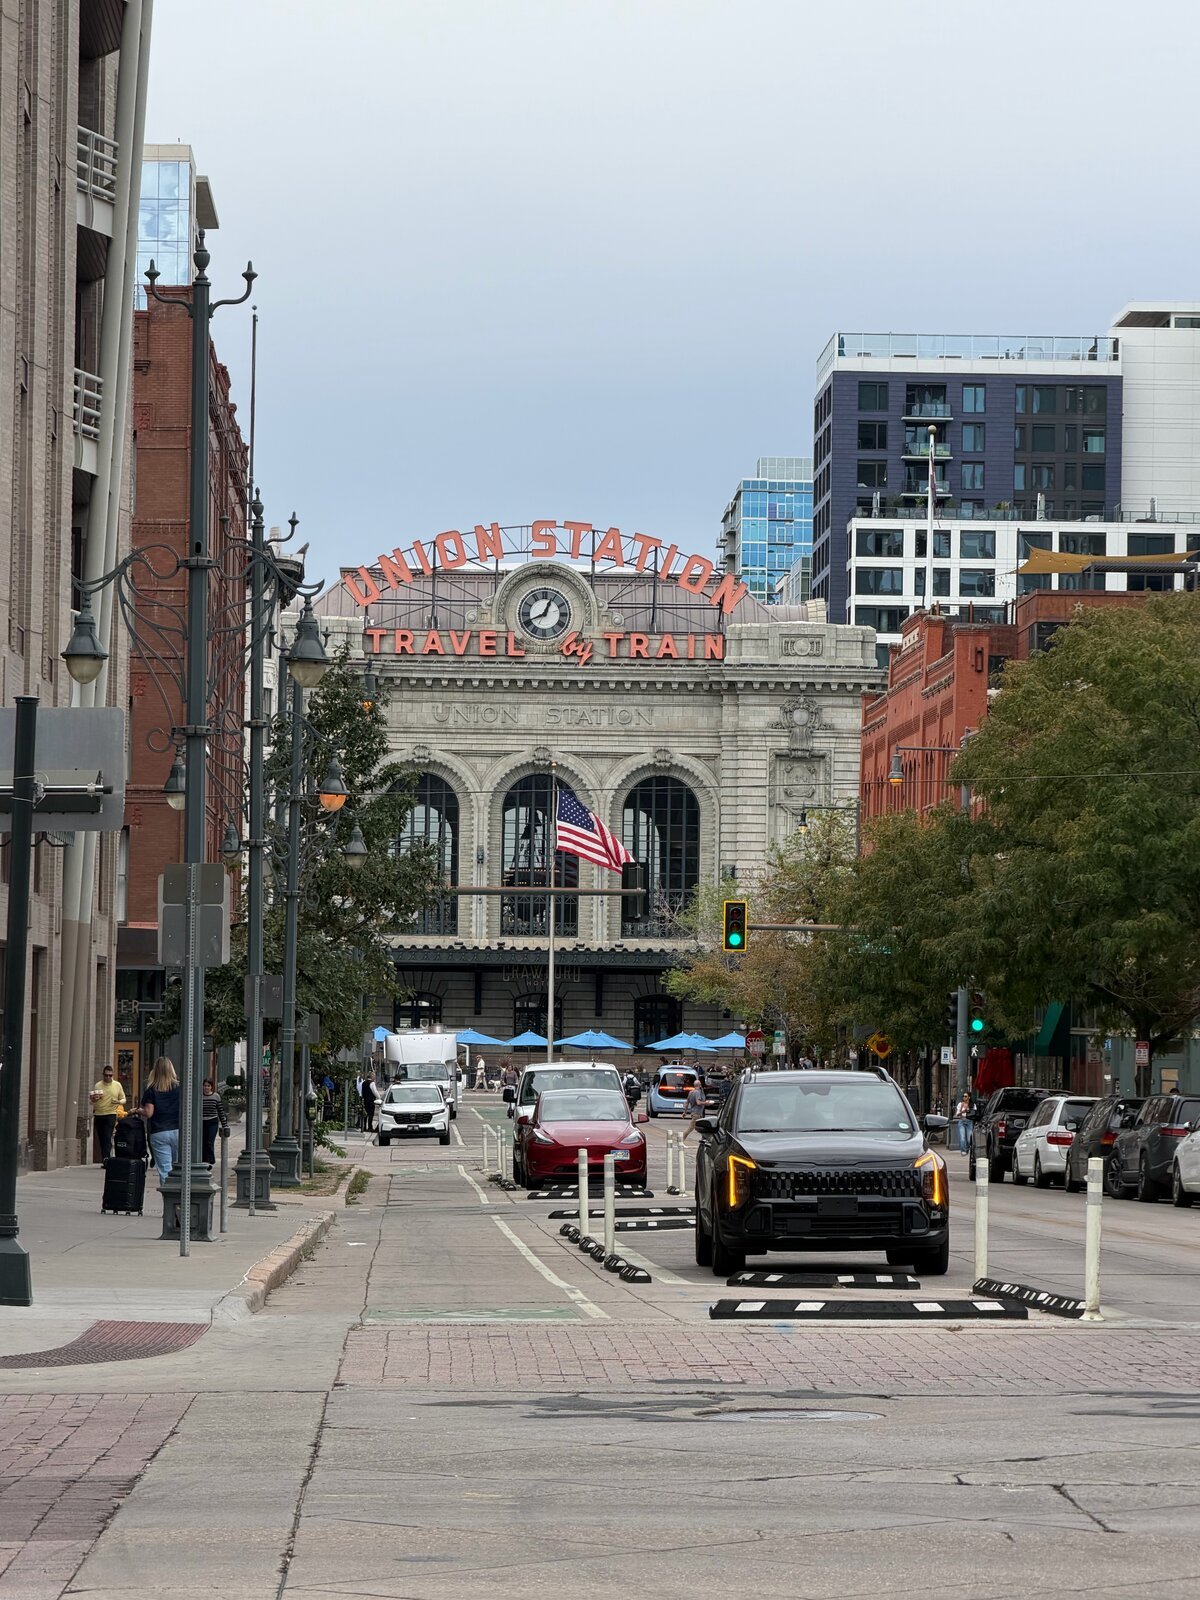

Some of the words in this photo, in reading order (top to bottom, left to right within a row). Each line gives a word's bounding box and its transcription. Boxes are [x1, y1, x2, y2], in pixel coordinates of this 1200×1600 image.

[343, 522, 504, 607] UNION
[531, 520, 748, 615] STATION
[366, 629, 526, 657] TRAVEL
[560, 631, 593, 666] by
[603, 632, 725, 660] TRAIN
[432, 704, 521, 724] UNION
[545, 706, 655, 726] STATION
